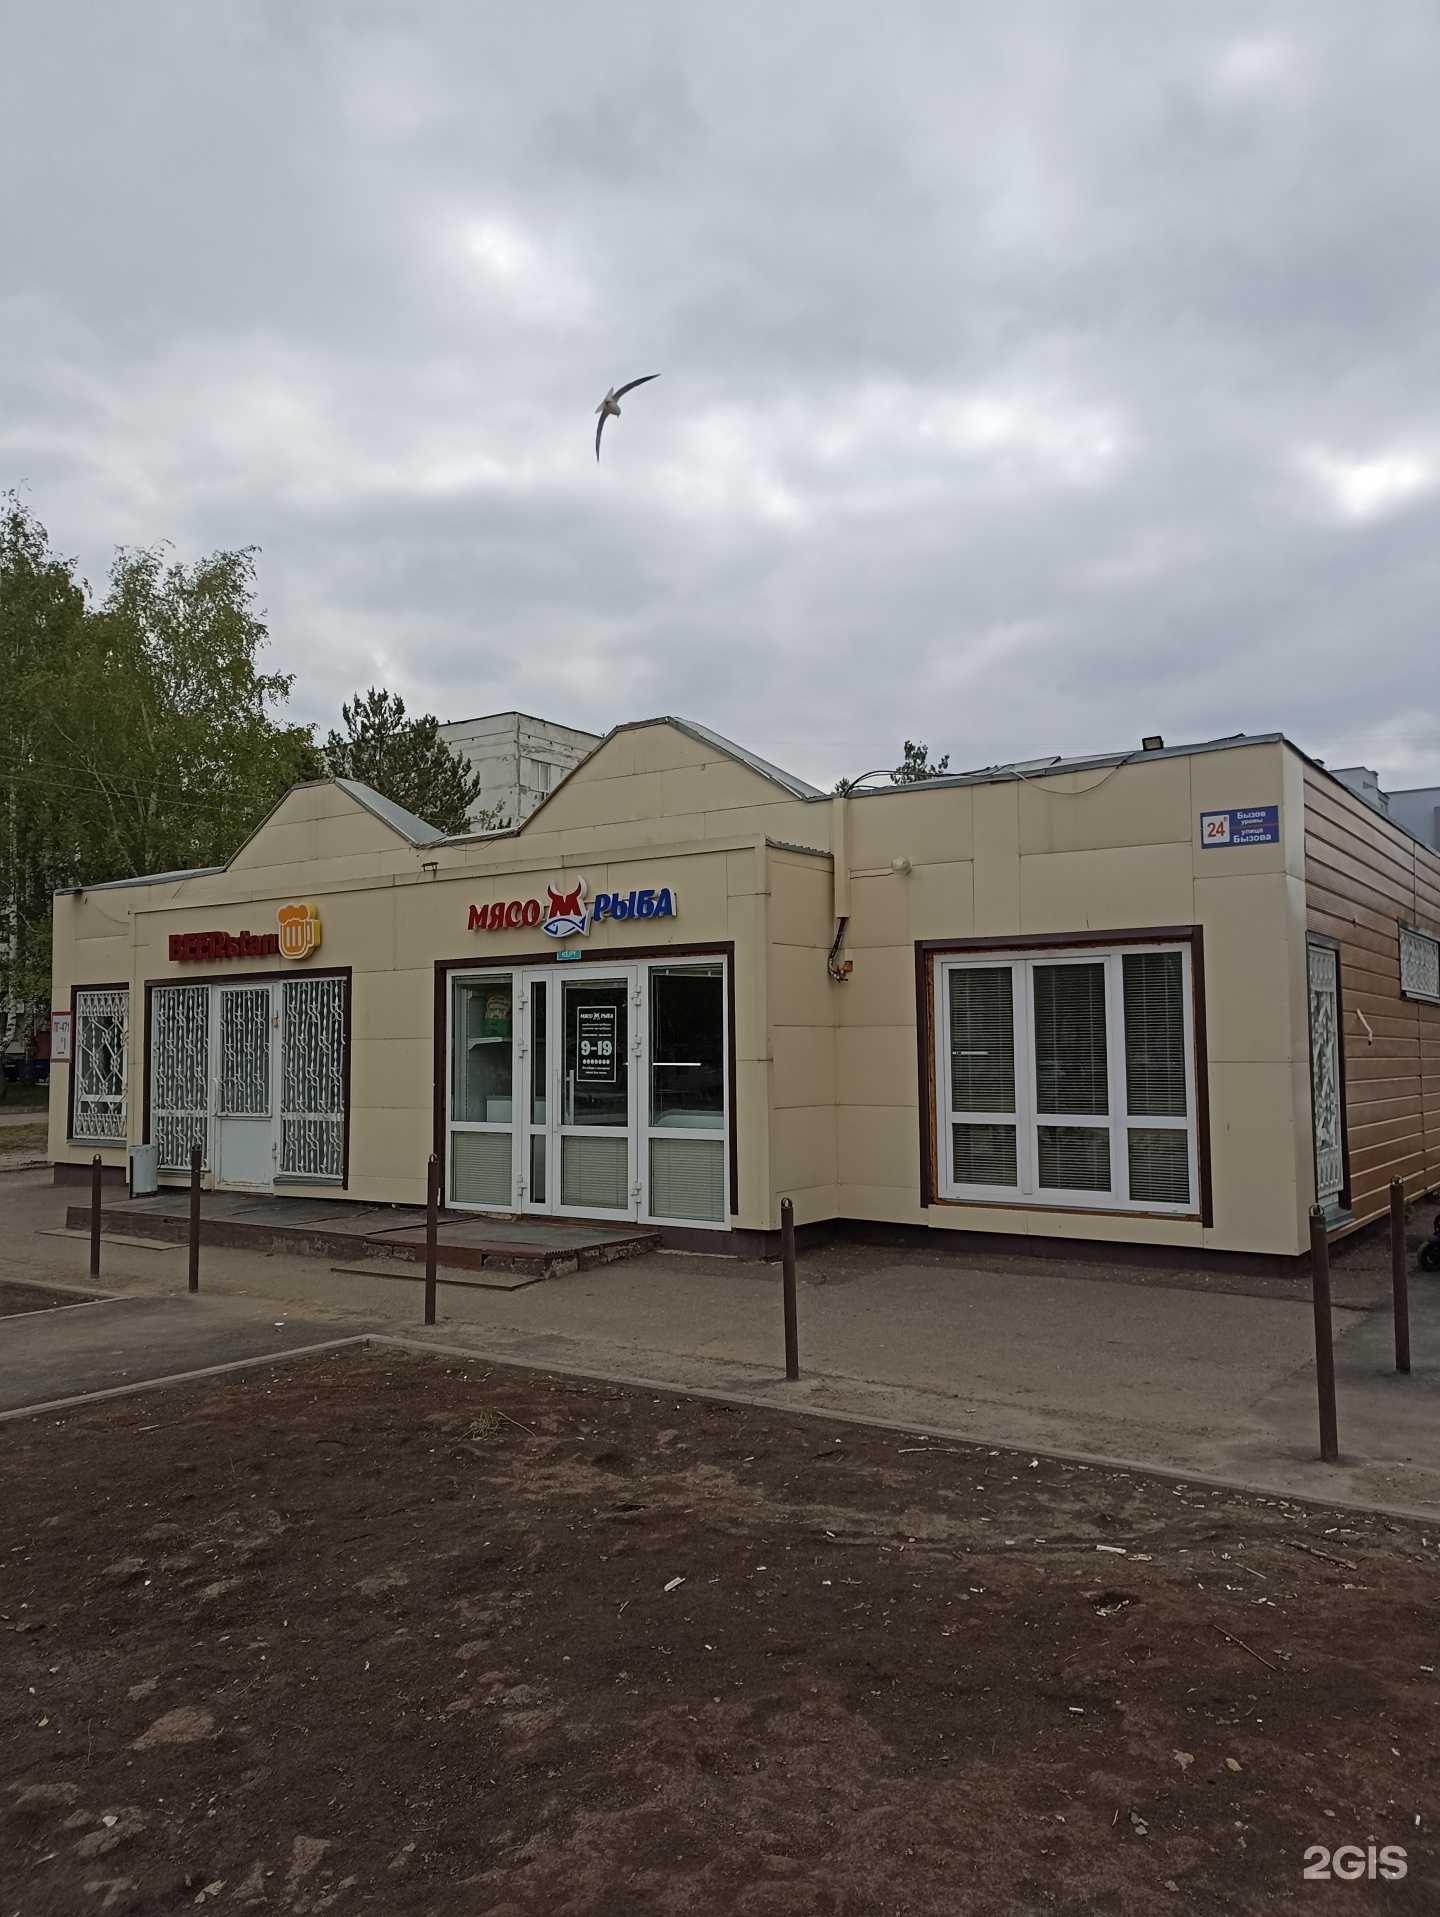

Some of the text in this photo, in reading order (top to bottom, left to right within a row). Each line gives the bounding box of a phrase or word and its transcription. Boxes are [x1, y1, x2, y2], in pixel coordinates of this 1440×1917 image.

[1236, 811, 1266, 819] Бызов
[1233, 834, 1272, 843] Бызова
[468, 899, 541, 930] МЯСО
[593, 888, 673, 921] РЫБА
[580, 1040, 612, 1056] 9-19
